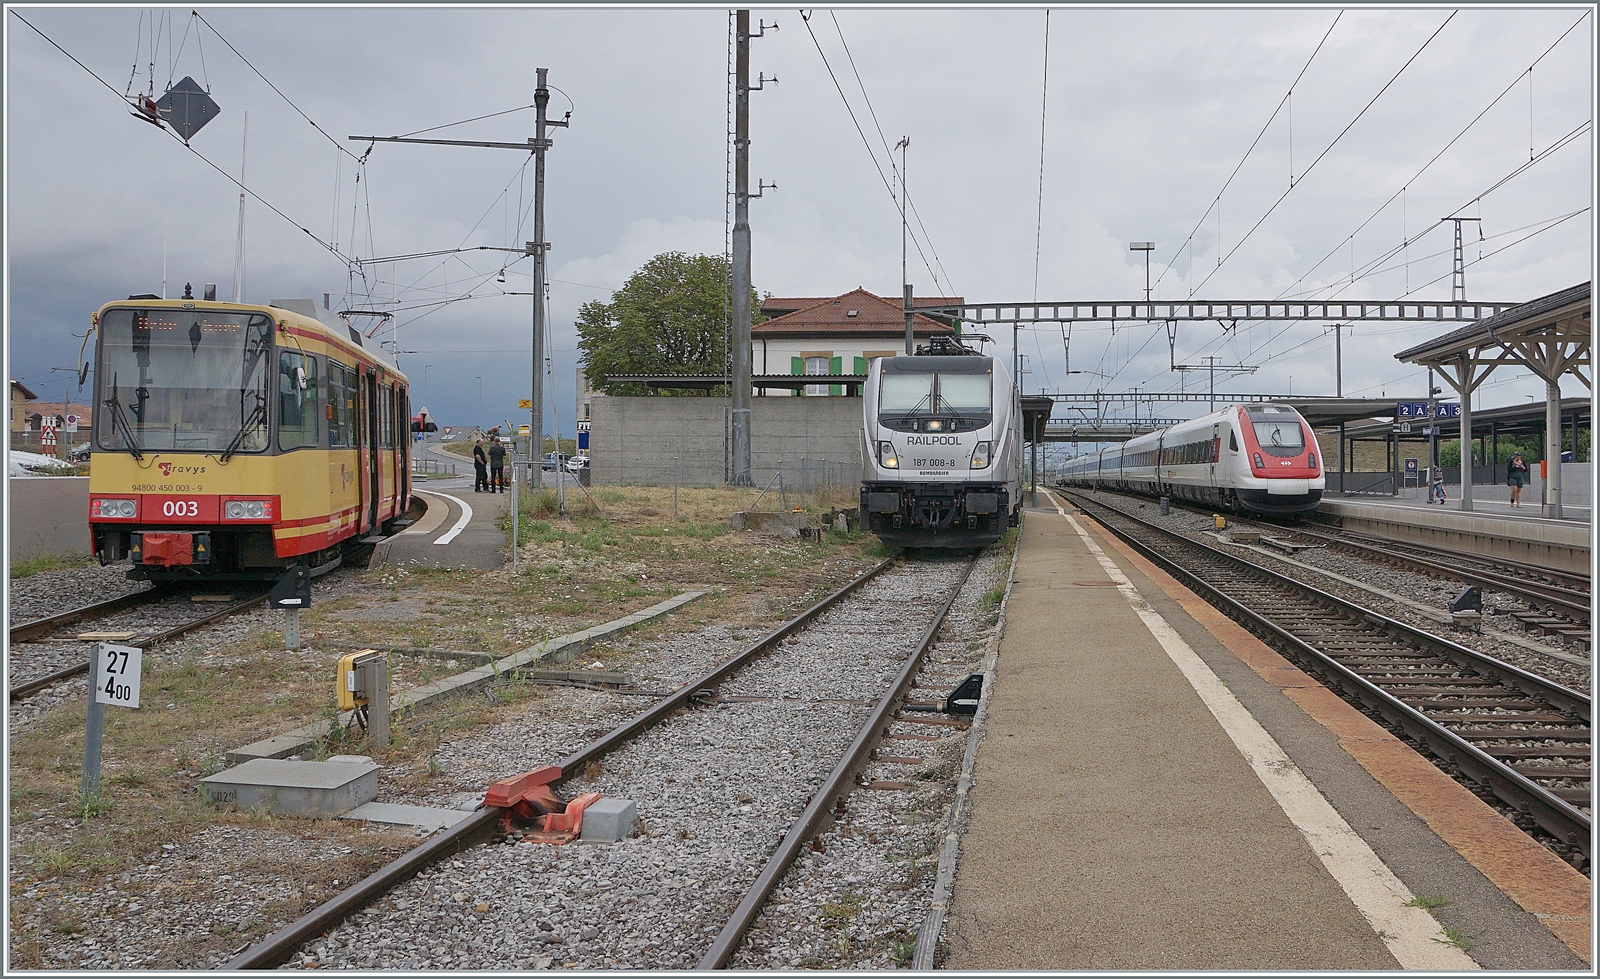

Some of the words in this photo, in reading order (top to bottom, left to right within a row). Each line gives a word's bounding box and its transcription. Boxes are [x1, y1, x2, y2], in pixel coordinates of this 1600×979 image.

[1403, 407, 1409, 415] 2
[1455, 407, 1460, 415] 3
[907, 436, 962, 446] RAILPOOL
[913, 458, 926, 467] 187
[929, 458, 956, 467] 008-8
[158, 462, 206, 476] travys
[131, 484, 156, 492] 94800
[158, 484, 173, 492] 450
[175, 484, 190, 492] 003
[197, 484, 203, 492] 9
[163, 500, 198, 517] 003
[106, 650, 129, 675] 27
[104, 676, 131, 701] 400
